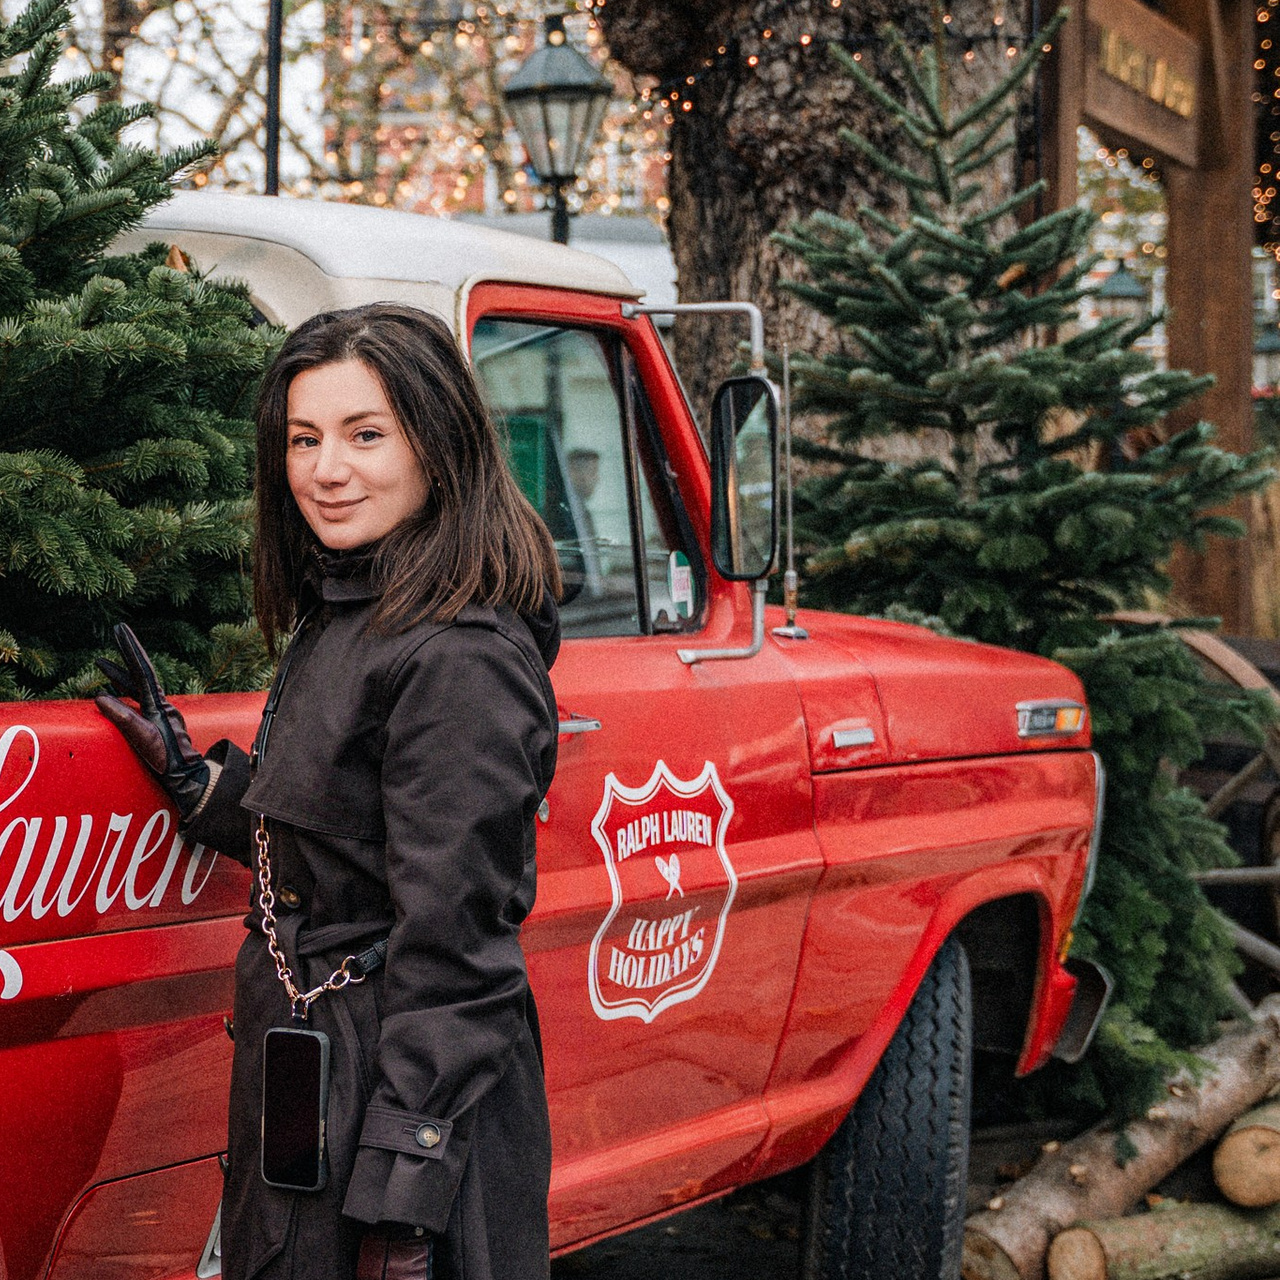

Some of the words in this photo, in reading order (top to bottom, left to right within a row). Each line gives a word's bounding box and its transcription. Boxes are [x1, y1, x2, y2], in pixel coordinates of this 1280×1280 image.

[617, 812, 661, 862] RALPH
[664, 810, 713, 848] LAUREN
[627, 906, 701, 951] HAPPY
[607, 927, 706, 989] HOLIDAYS
